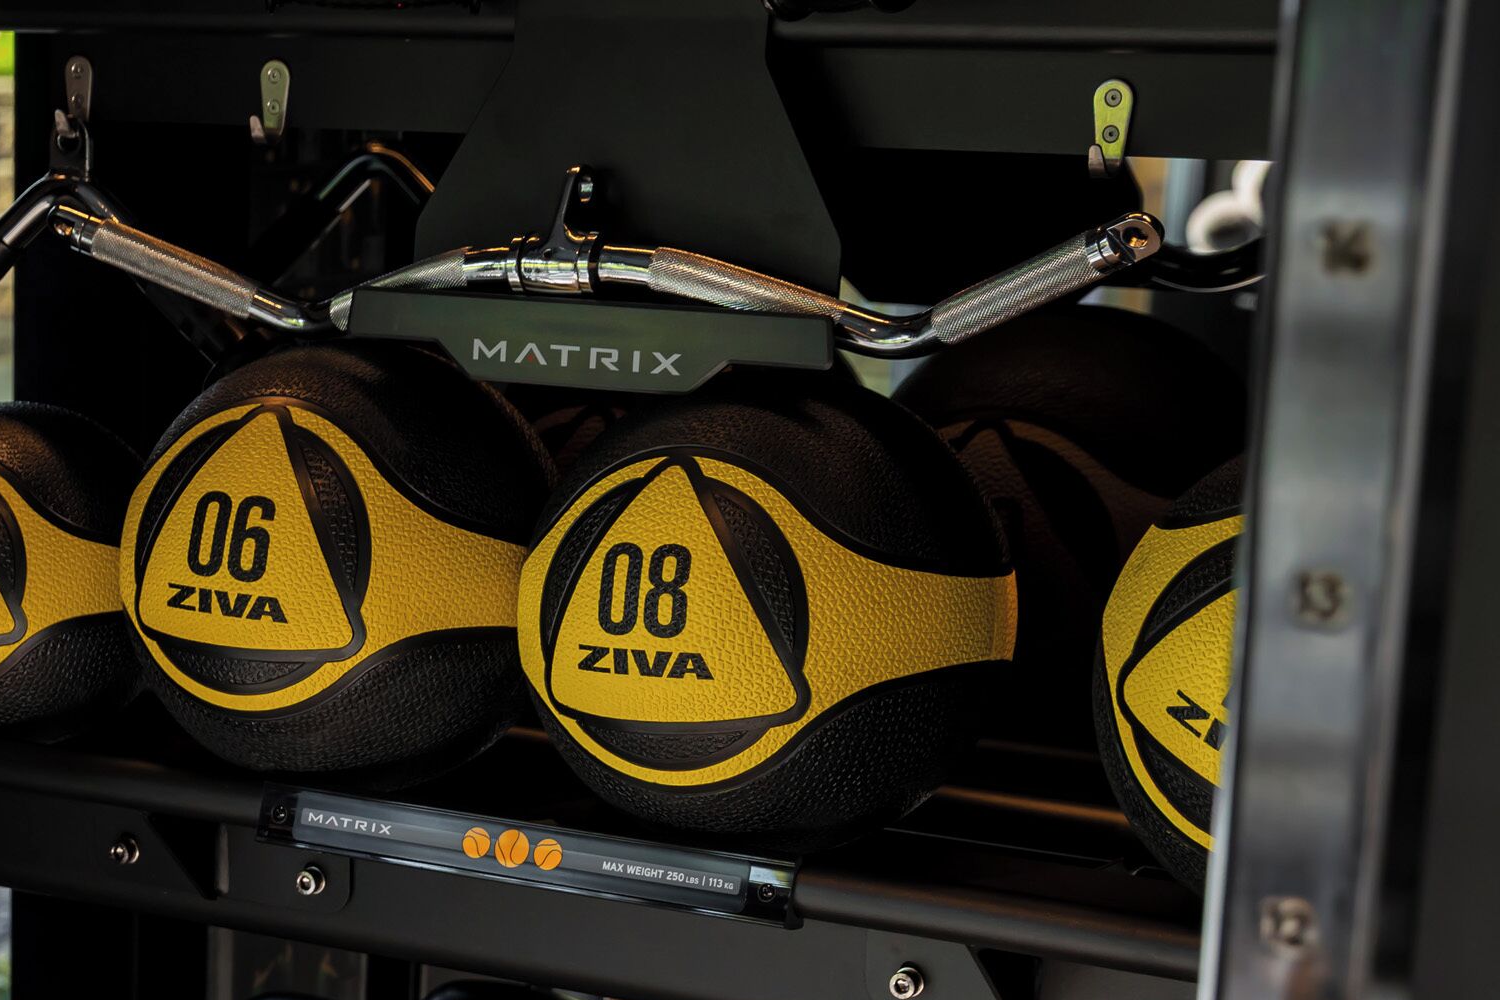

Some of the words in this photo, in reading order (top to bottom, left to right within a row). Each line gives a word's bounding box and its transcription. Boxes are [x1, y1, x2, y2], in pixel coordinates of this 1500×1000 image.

[472, 338, 682, 376] MATRIX
[187, 490, 276, 583] 06
[167, 582, 288, 624] ZIVA
[598, 542, 692, 639] 08
[578, 643, 714, 681] ZIVA
[1166, 689, 1228, 751] ZI
[308, 812, 392, 835] MATRIX
[602, 861, 625, 873] MAX
[626, 864, 664, 879] WEIGHT
[666, 871, 685, 882] 250
[685, 875, 700, 885] LBS
[708, 877, 723, 888] 113
[724, 882, 734, 890] KG
